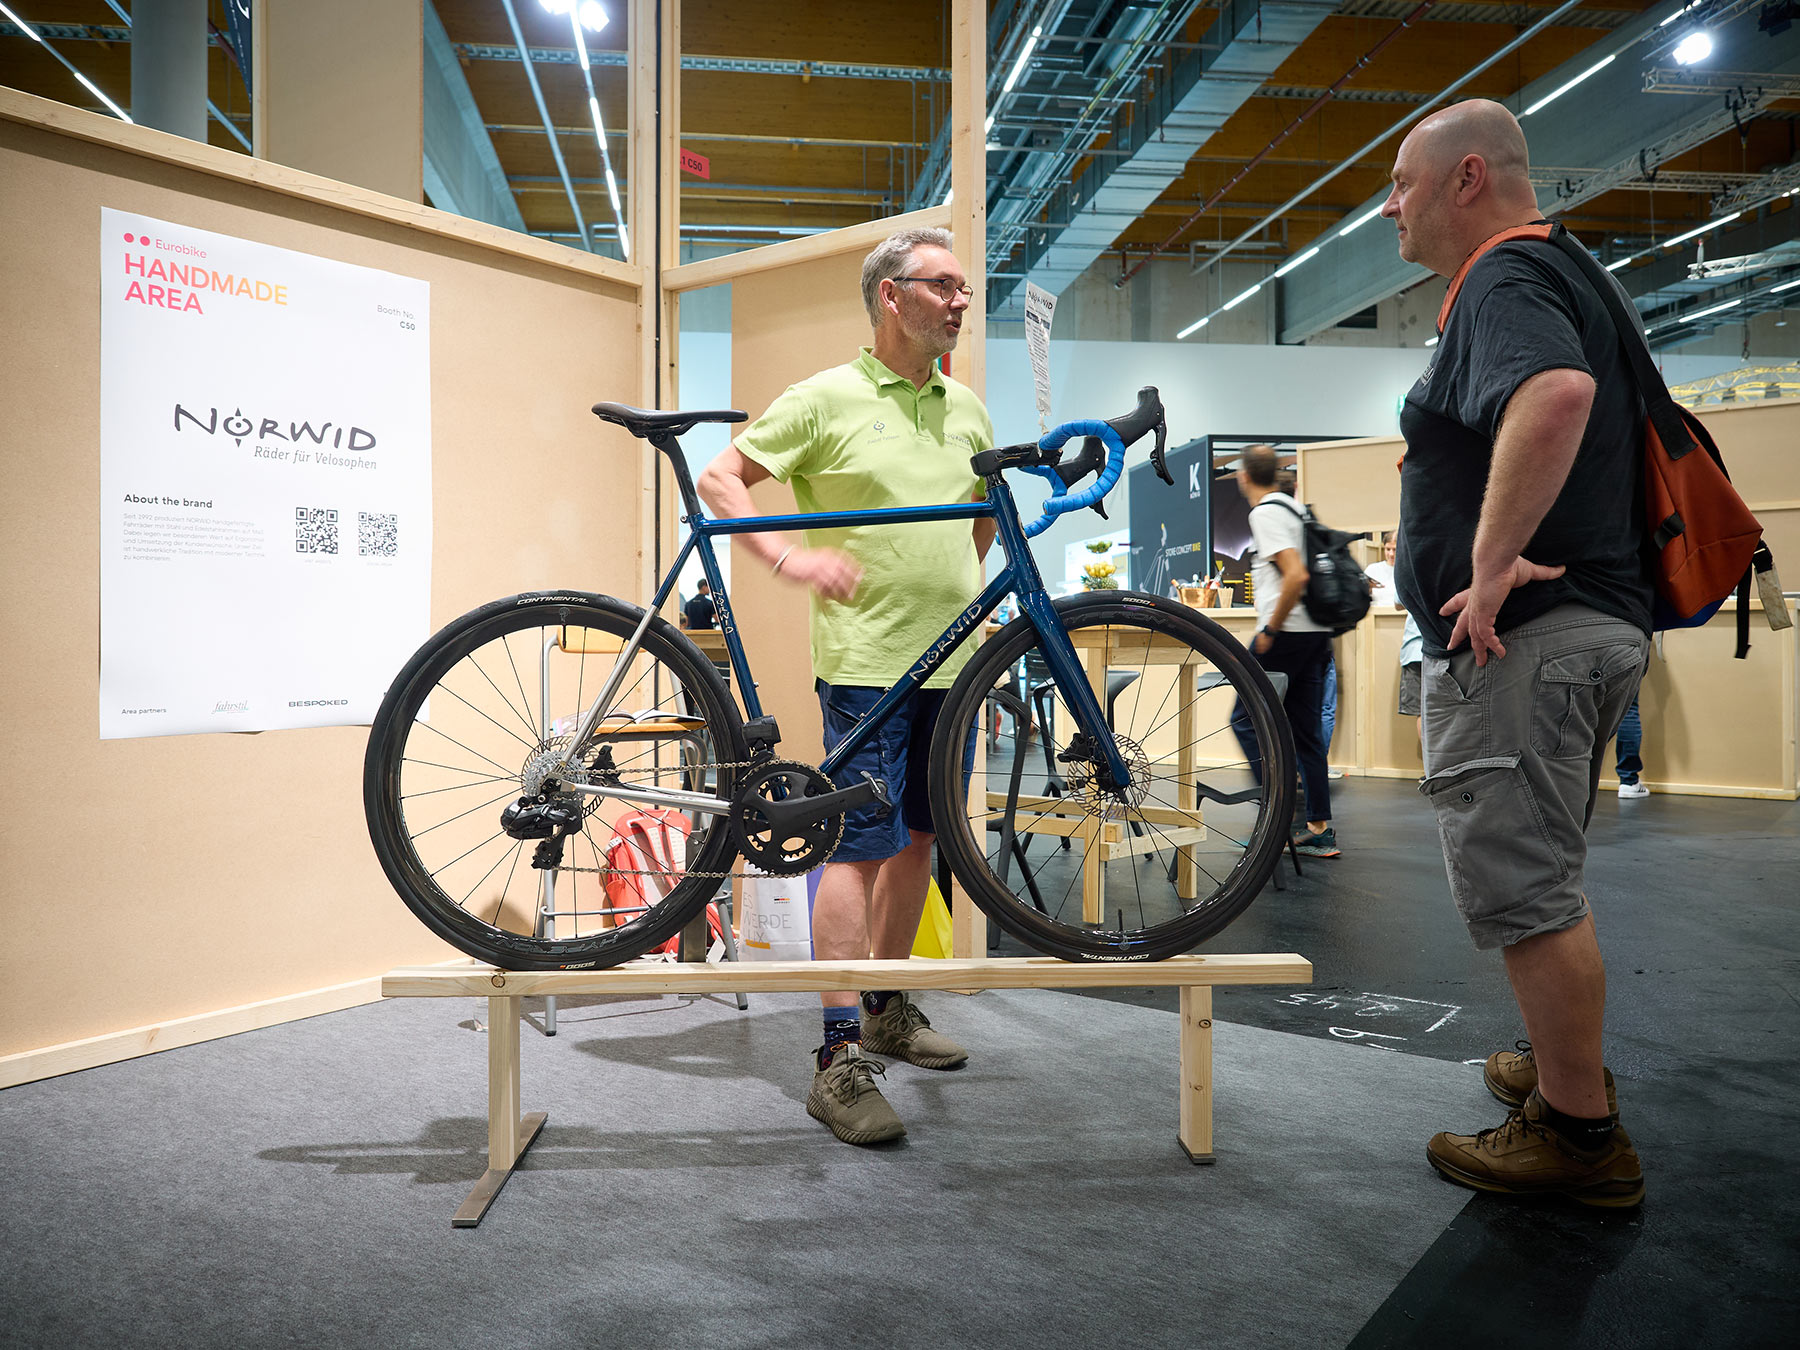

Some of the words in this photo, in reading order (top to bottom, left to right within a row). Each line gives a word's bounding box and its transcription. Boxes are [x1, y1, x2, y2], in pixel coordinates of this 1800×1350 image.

[687, 158, 703, 172] C50
[155, 238, 207, 259] Eurobike
[125, 253, 288, 306] HANDMADE
[124, 281, 204, 315] AREA
[377, 304, 401, 316] Booth
[399, 320, 416, 331] C50
[174, 403, 377, 451] NORWID
[253, 444, 291, 461] Räder
[293, 449, 311, 464] für
[315, 451, 377, 471] Velosophen
[1189, 461, 1201, 493] K
[123, 493, 159, 505] About
[162, 496, 181, 506] the
[183, 498, 213, 509] brand
[516, 596, 589, 606] CONTINENTAL
[1121, 597, 1152, 605] 5000
[713, 588, 735, 635] NORWID
[909, 603, 983, 682] NORWID
[139, 707, 168, 716] partners
[288, 699, 349, 708] BESPOKED
[1080, 952, 1150, 962] CONTINENTAL
